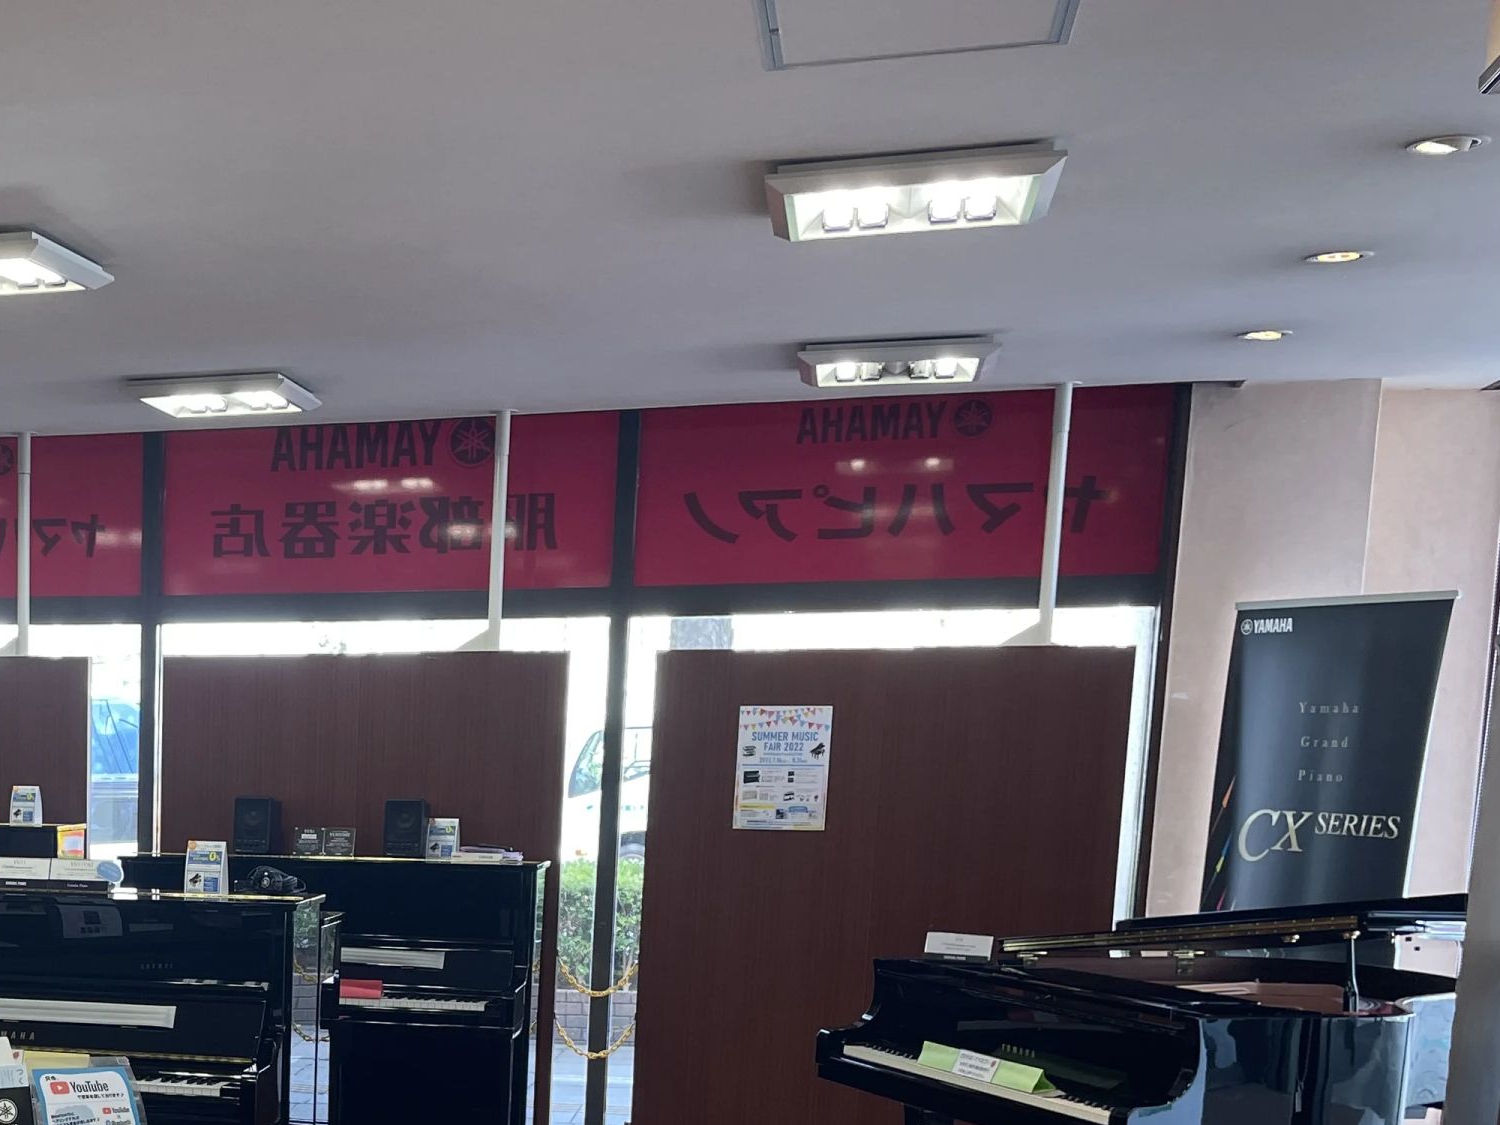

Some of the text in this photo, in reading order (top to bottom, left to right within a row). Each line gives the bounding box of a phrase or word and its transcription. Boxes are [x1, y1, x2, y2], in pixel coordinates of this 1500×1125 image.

[1253, 617, 1293, 634] YAMAHA
[1299, 701, 1360, 715] Yamaha
[751, 731, 819, 742] SUMMER MUSIC
[1300, 735, 1350, 750] Grand
[763, 742, 804, 752] FAIR 2022
[1297, 769, 1344, 783] Piano
[1238, 807, 1401, 863] CX SERIES
[69, 1080, 109, 1094] YouTube
